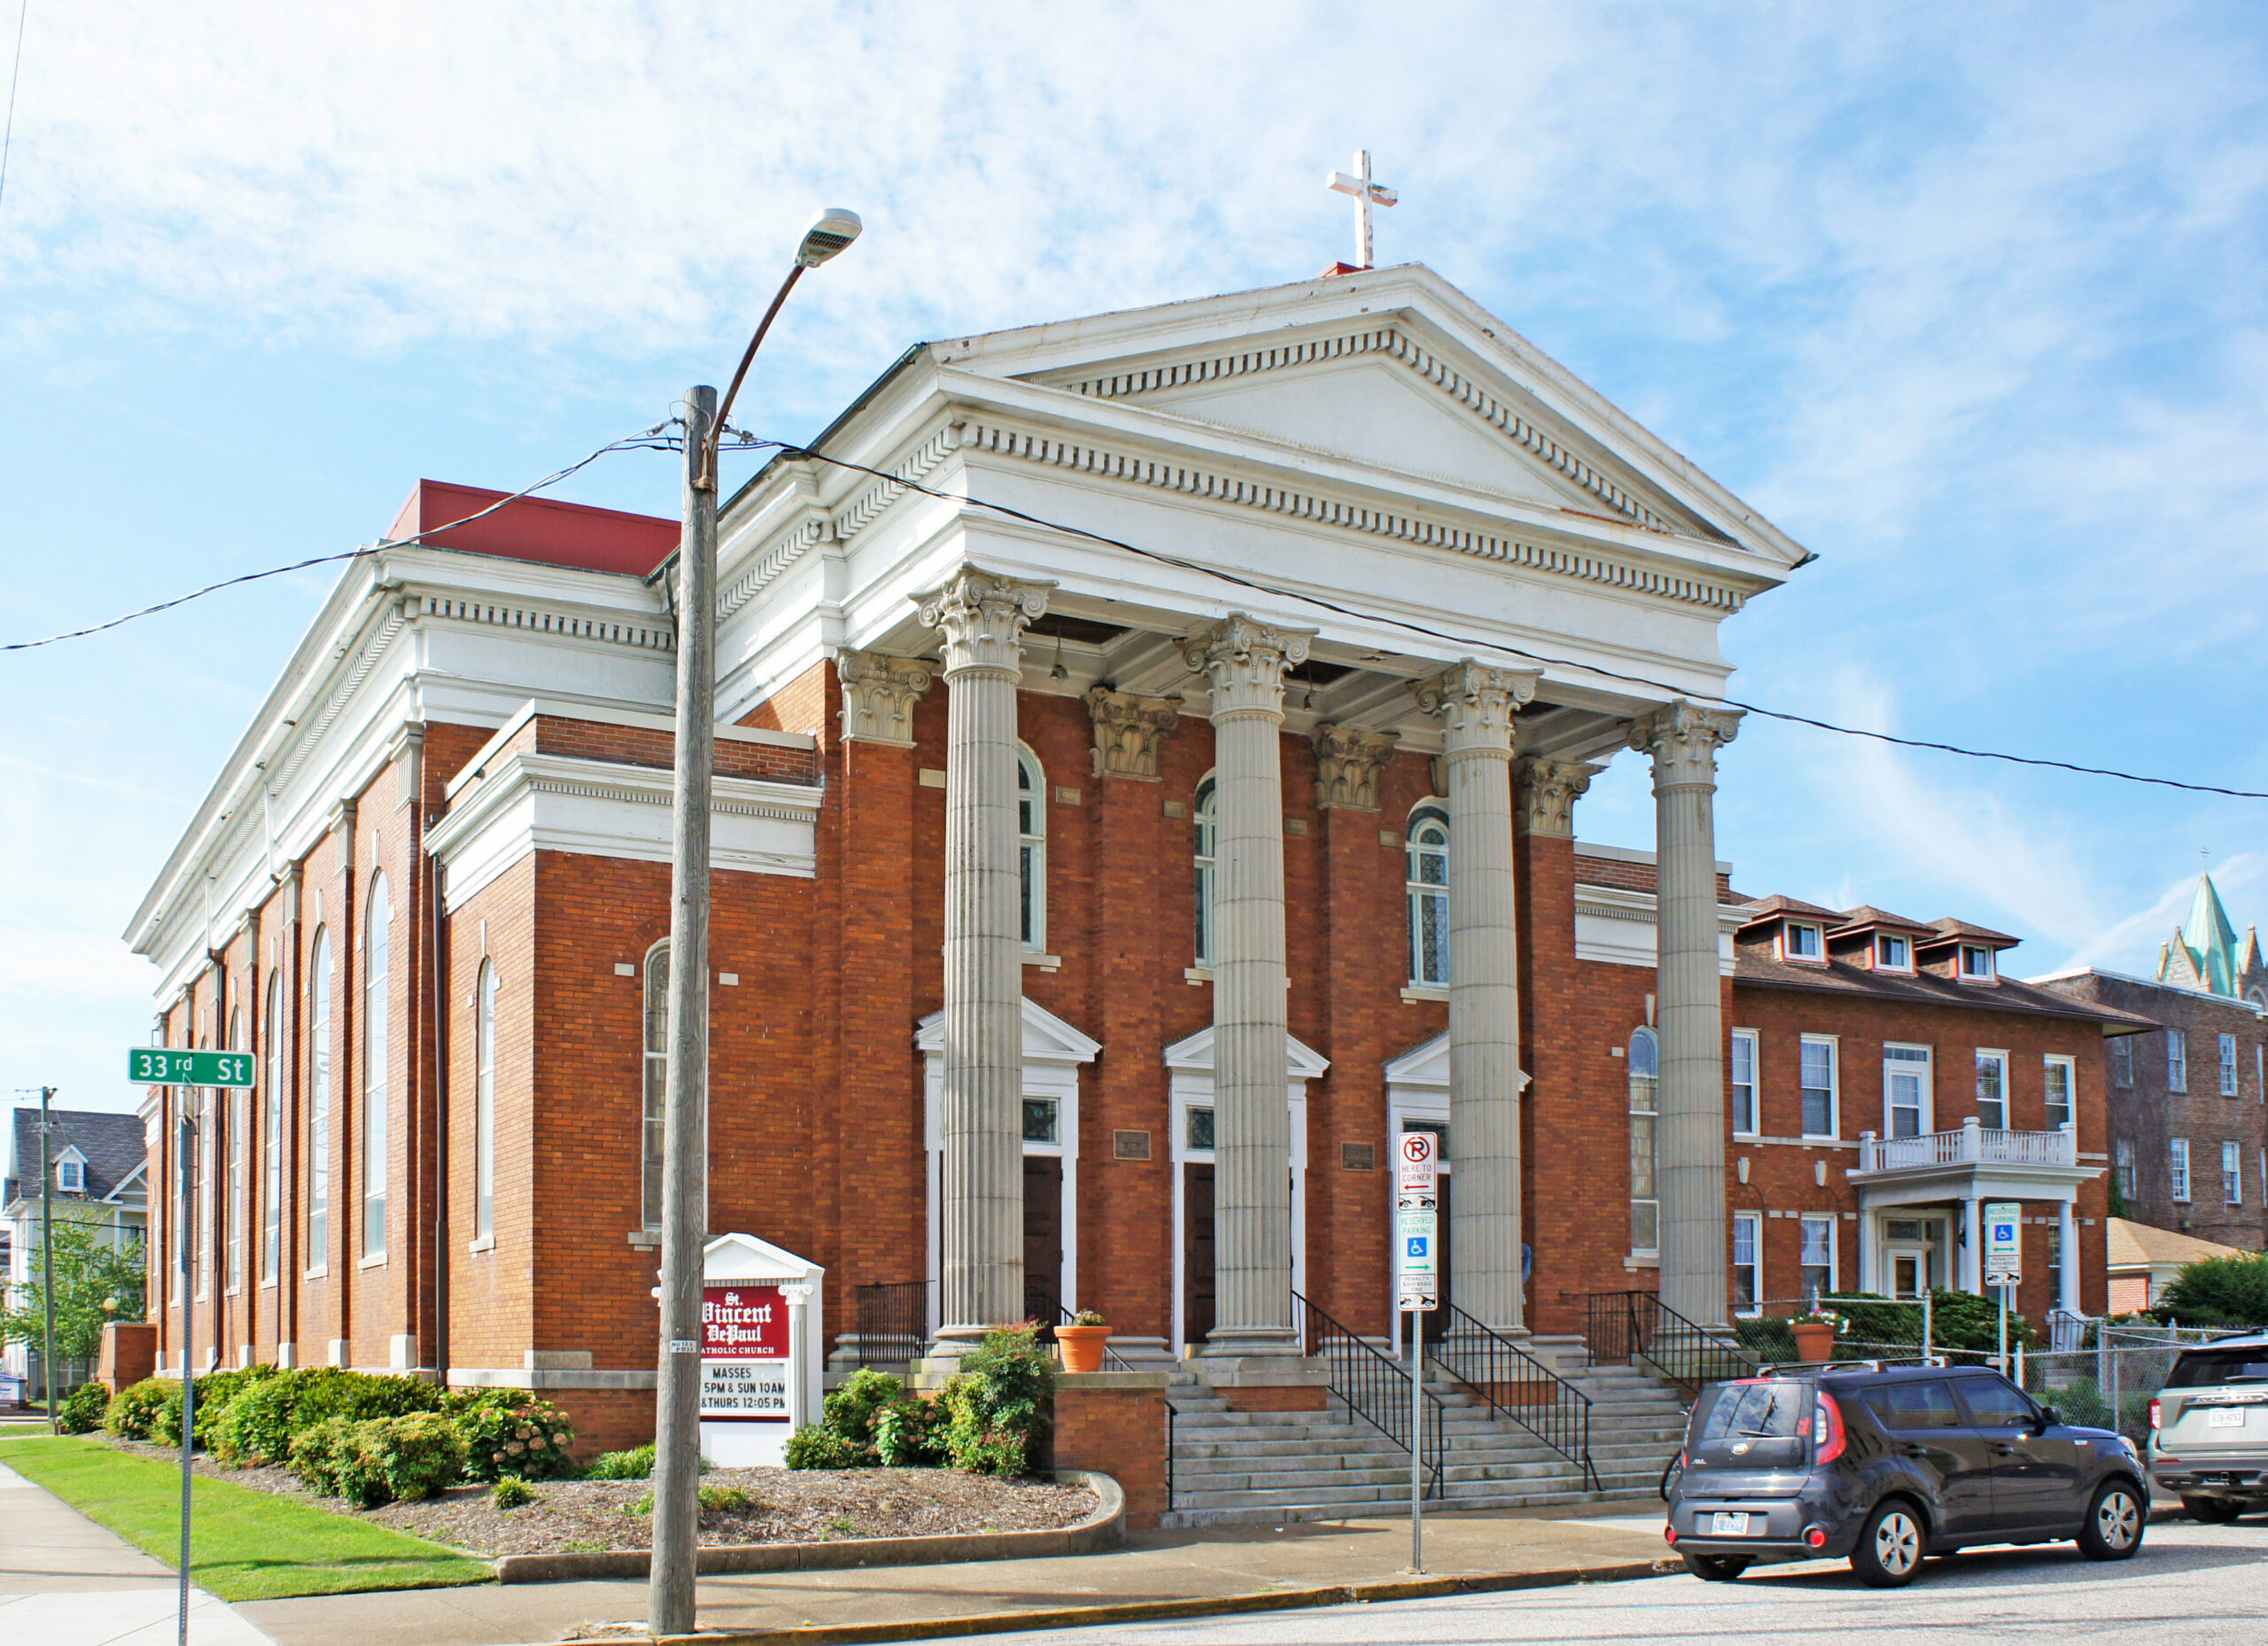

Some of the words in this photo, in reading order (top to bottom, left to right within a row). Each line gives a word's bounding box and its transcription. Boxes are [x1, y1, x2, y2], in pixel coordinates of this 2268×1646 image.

[218, 1059, 244, 1081] St
[702, 1301, 772, 1324] Vincent
[707, 1324, 762, 1346] DePaul
[712, 1367, 751, 1378] MASSES
[704, 1383, 725, 1394] 5PM
[727, 1383, 734, 1394] &
[738, 1383, 756, 1394] SUN
[743, 1397, 771, 1408] 12:05
